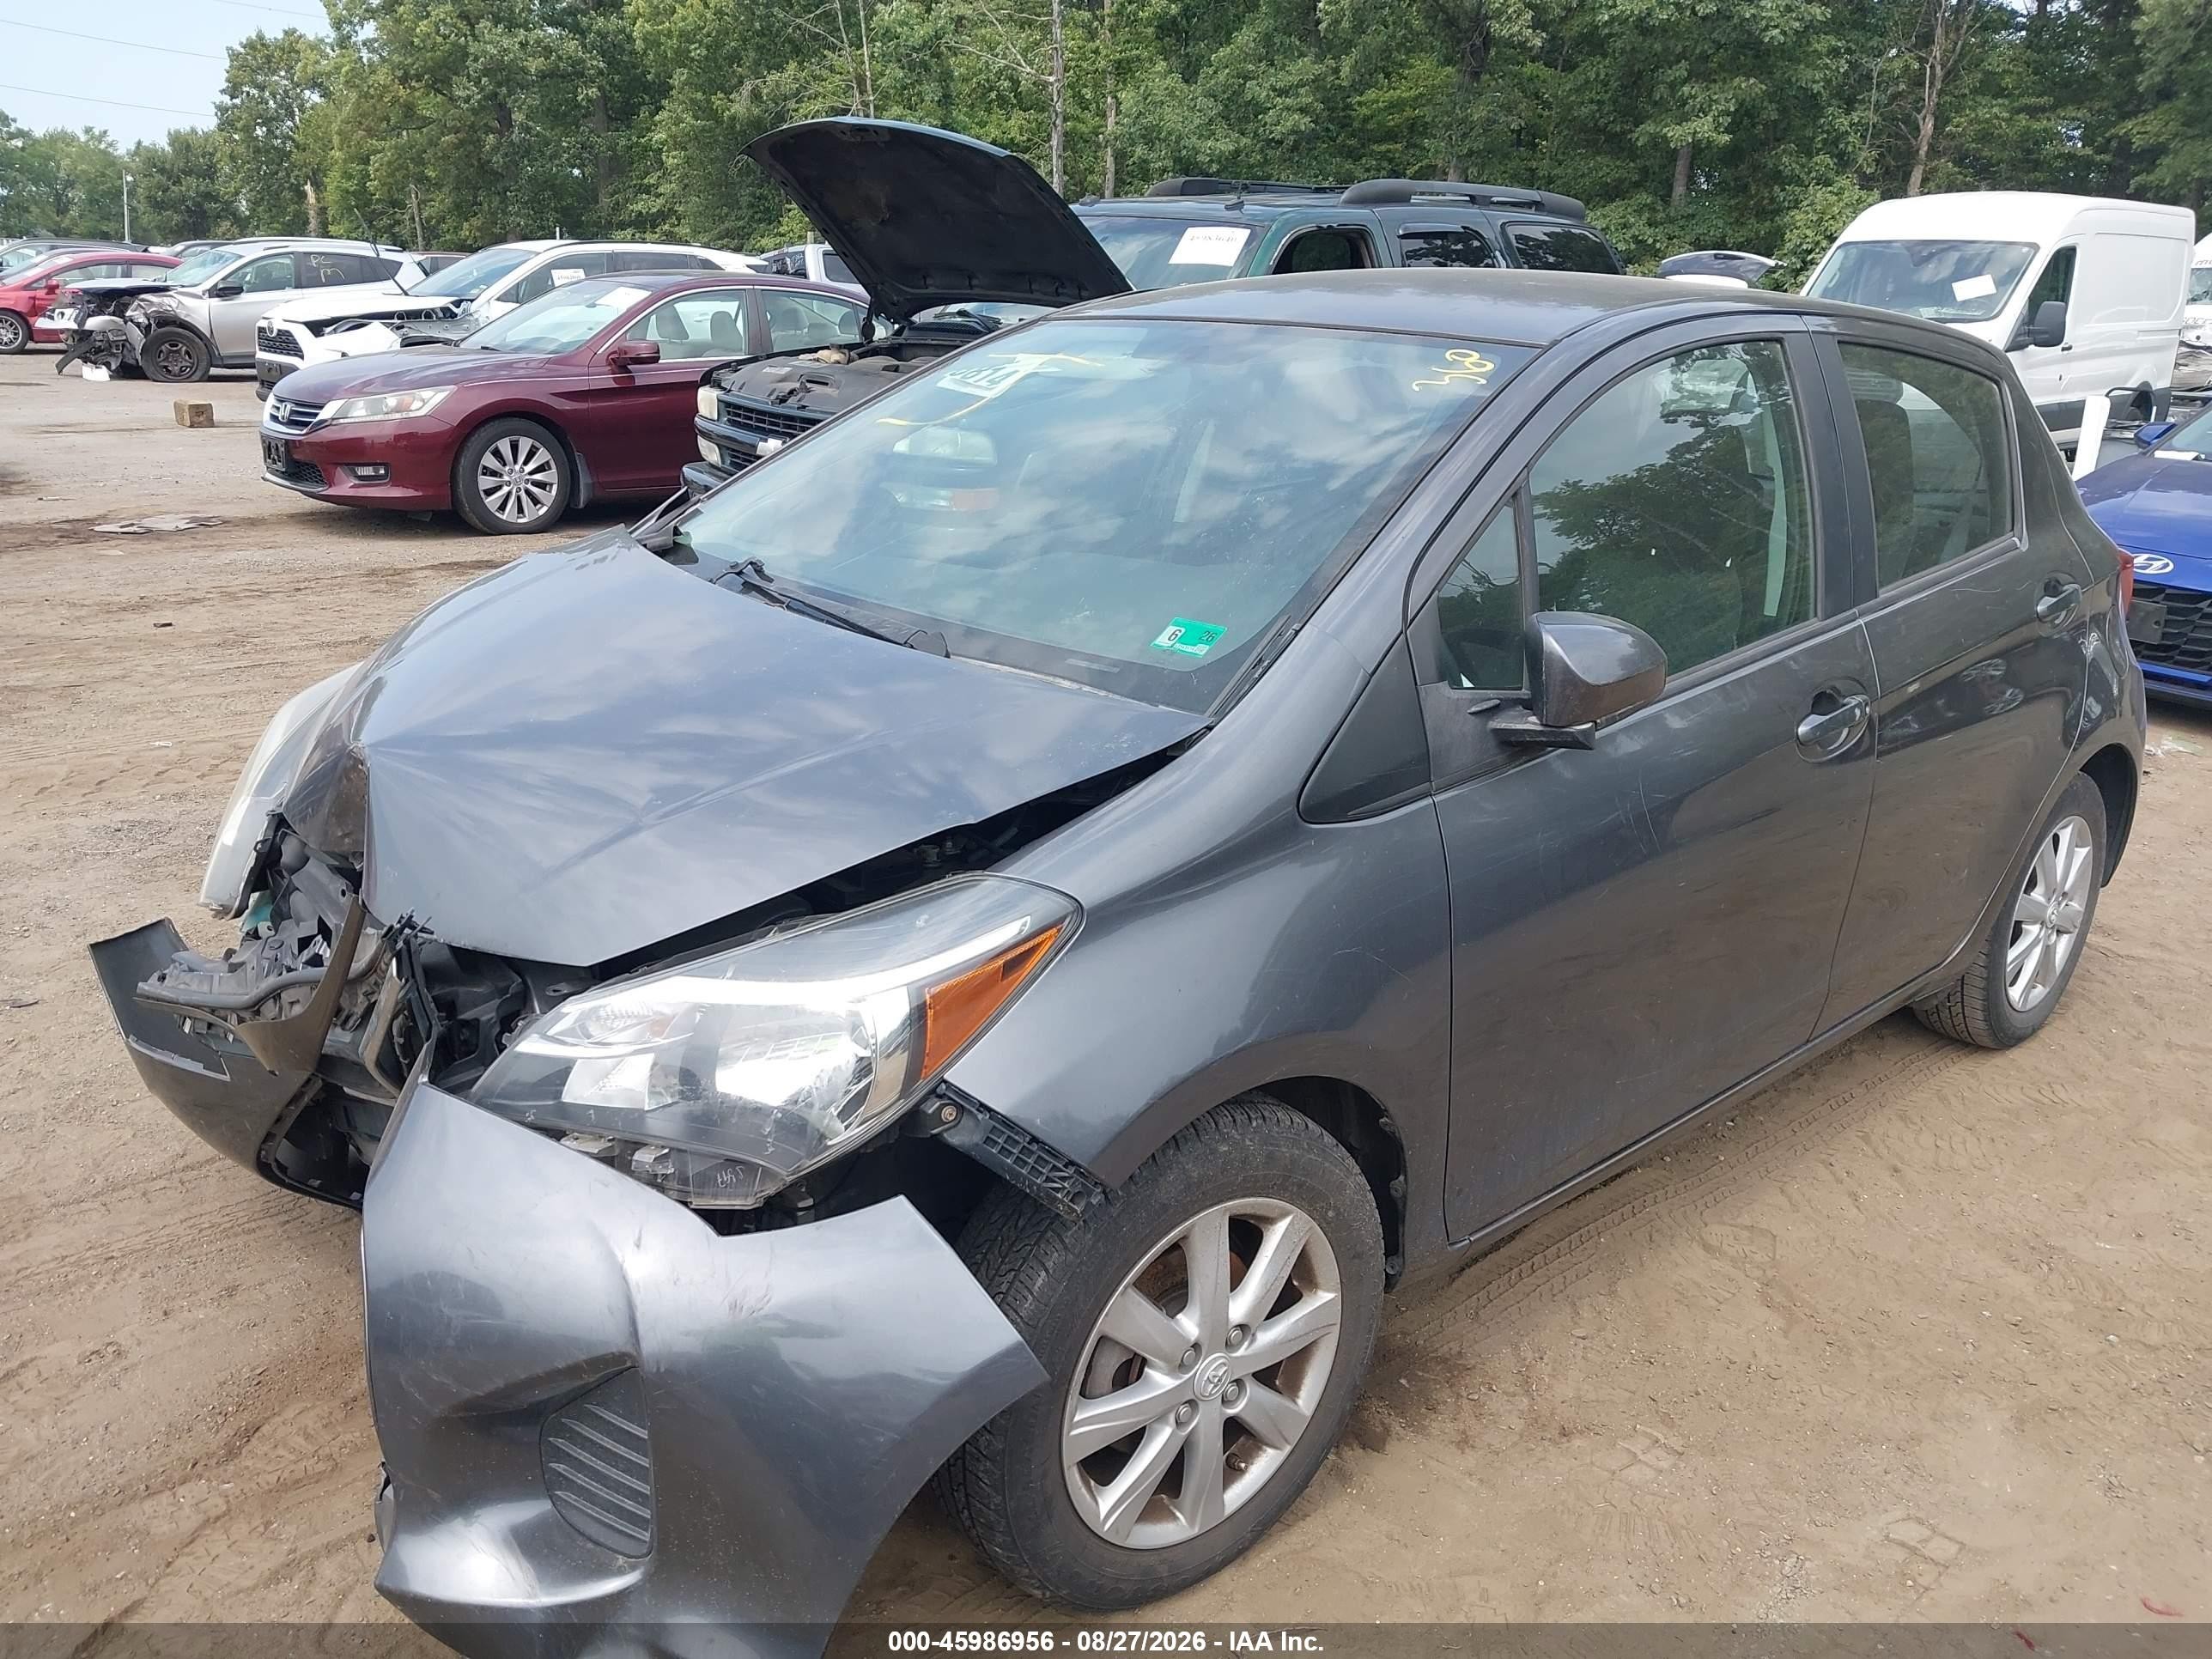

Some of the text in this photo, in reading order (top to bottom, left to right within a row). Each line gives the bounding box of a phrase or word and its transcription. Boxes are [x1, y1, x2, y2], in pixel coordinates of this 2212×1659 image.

[1411, 348, 1496, 392] 360
[1167, 629, 1218, 643] 6 26
